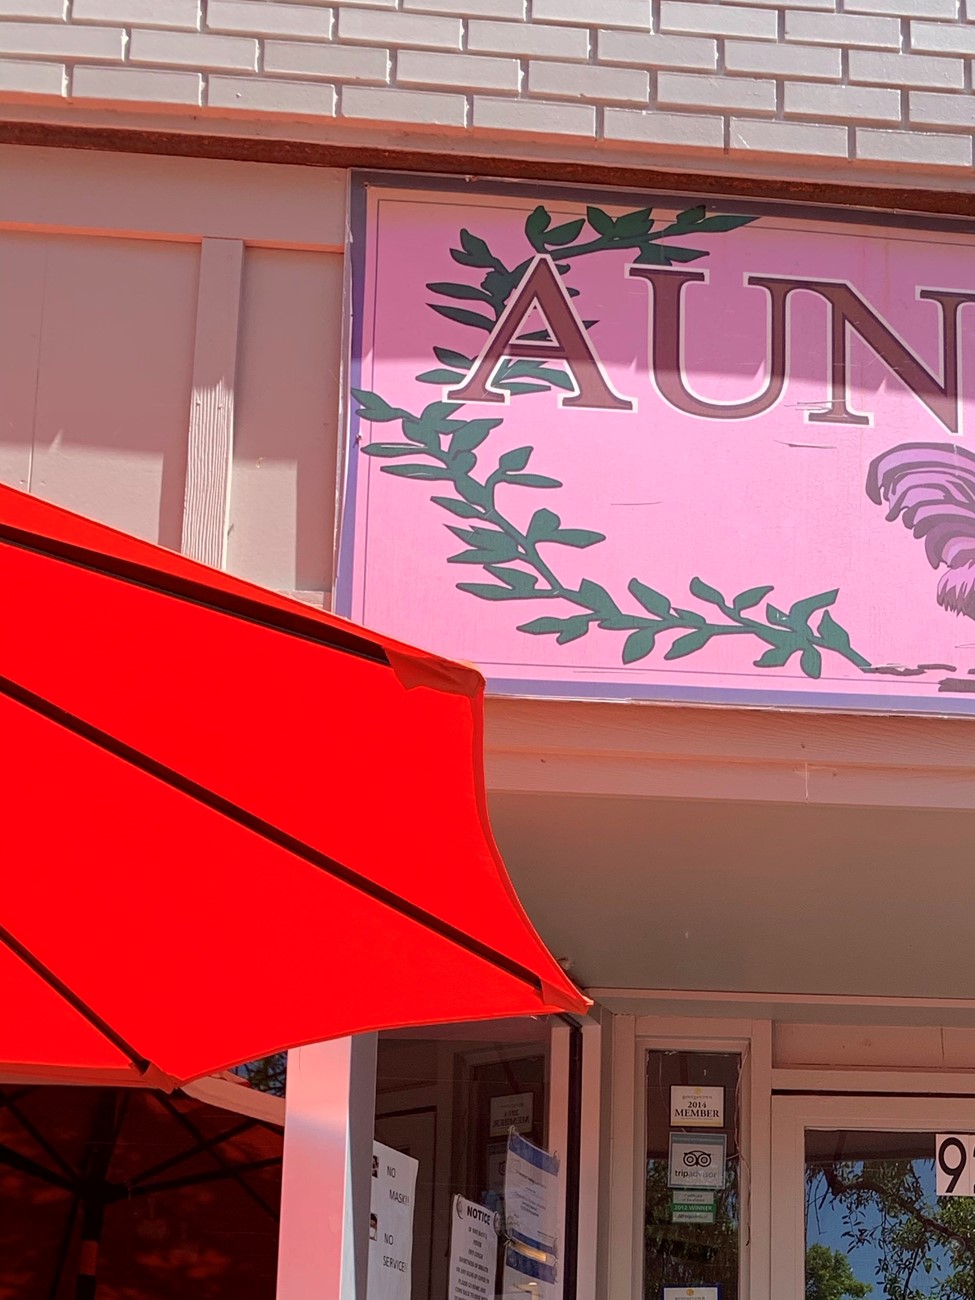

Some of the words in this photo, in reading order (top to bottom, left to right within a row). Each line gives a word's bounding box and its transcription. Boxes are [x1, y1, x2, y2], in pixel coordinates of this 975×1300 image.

[674, 1108, 720, 1118] MEMBER
[386, 1166, 396, 1178] NO
[674, 1170, 718, 1178] tripadvisor
[467, 1206, 490, 1225] NOTICE
[384, 1233, 394, 1245] NO
